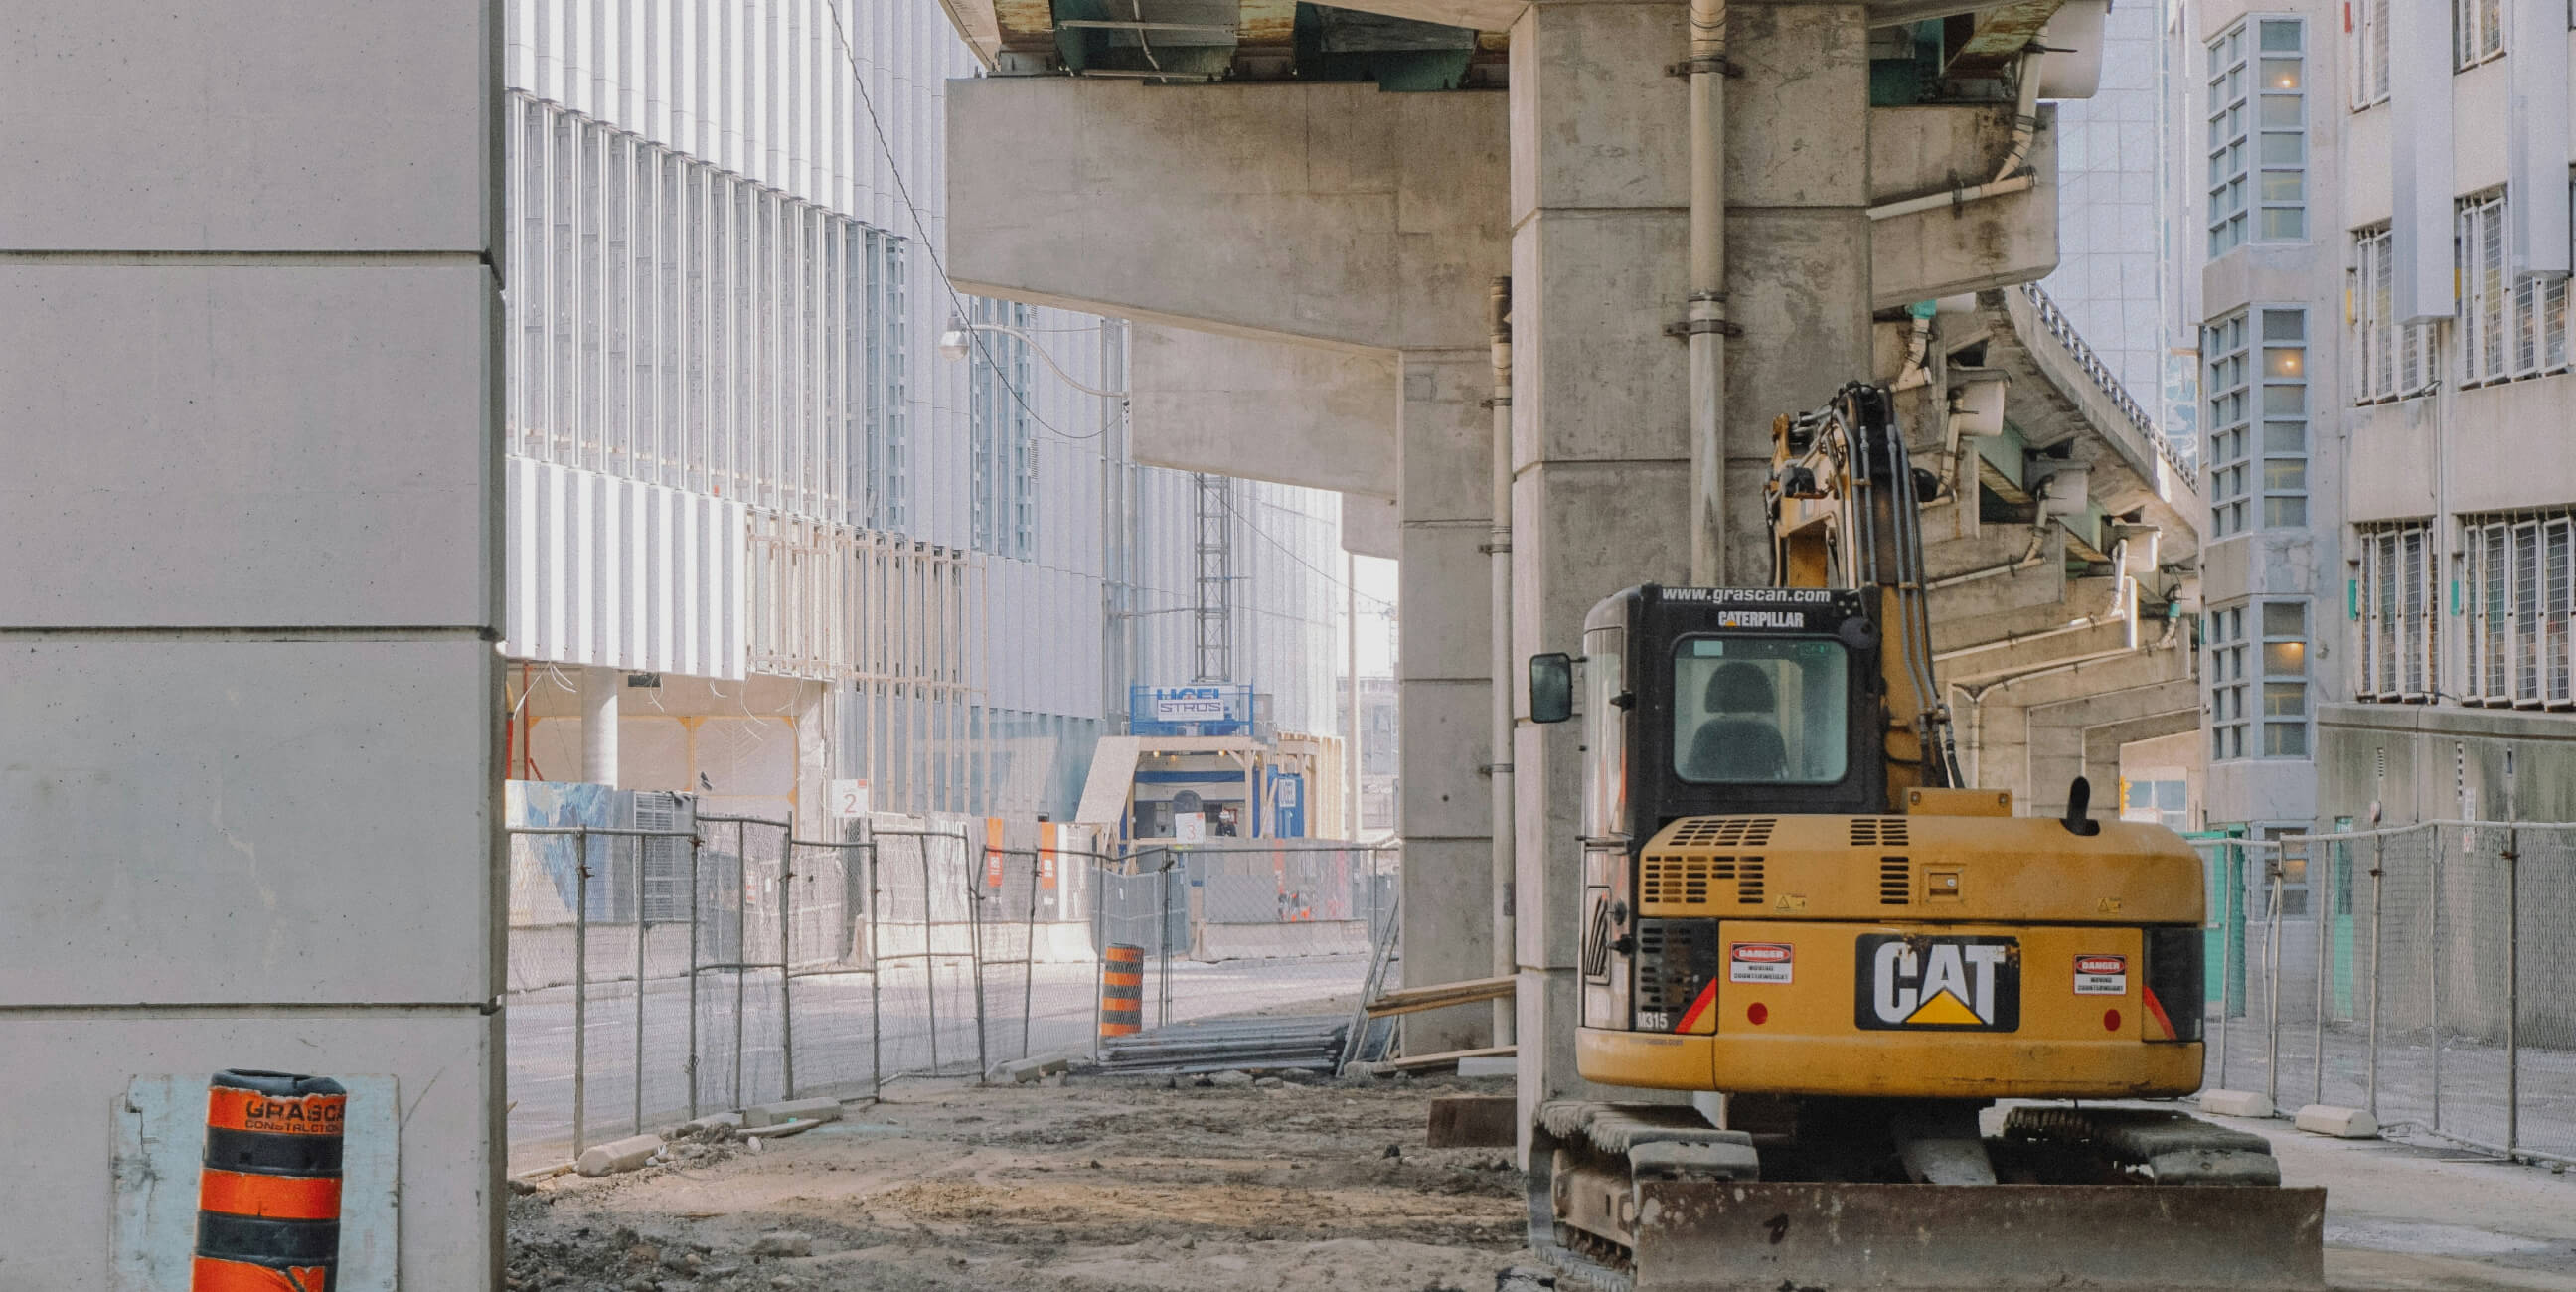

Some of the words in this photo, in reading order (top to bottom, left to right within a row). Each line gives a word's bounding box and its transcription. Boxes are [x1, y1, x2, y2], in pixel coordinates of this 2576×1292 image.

[1662, 588, 1831, 604] www.grascan.com
[1718, 611, 1804, 628] CATERPILLAR
[843, 793, 858, 814] 2
[1186, 823, 1197, 841] 3
[1739, 949, 1784, 959] DANGER
[2081, 961, 2120, 970] DANGER
[1874, 941, 2007, 1026] CAT
[1637, 1012, 1669, 1030] M315
